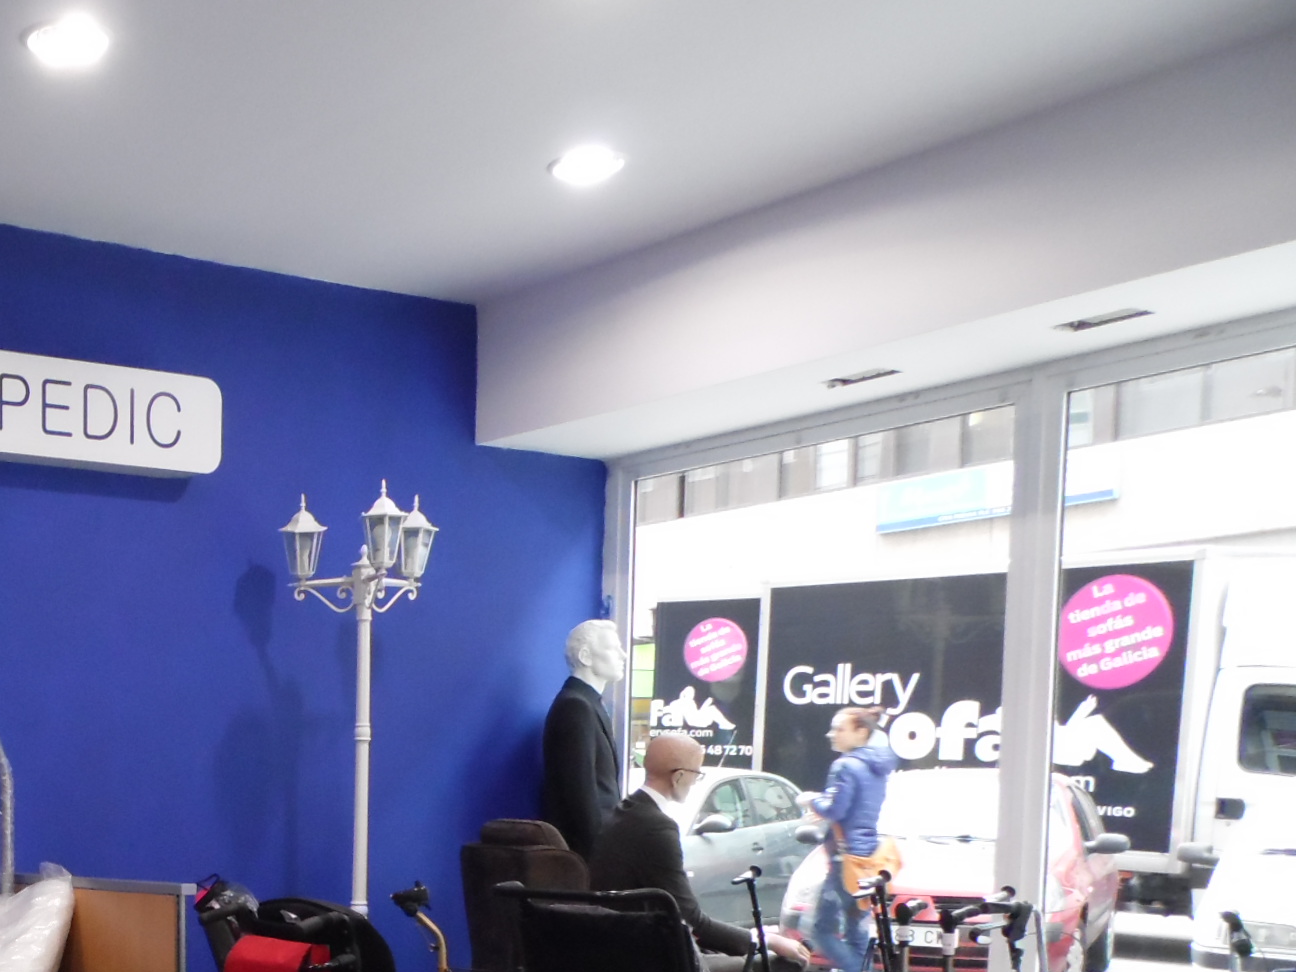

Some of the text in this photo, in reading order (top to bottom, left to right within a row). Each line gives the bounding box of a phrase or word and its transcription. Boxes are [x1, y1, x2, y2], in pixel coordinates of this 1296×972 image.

[1092, 583, 1115, 599] La
[1067, 592, 1147, 624] tienda de
[1086, 614, 1135, 637] sofás
[1066, 625, 1165, 662] más grande
[1076, 646, 1160, 678] de Galicia
[783, 662, 920, 715] Gallery
[879, 699, 1002, 763] ofa
[707, 745, 722, 756] 48
[738, 745, 753, 756] 70
[1097, 805, 1135, 818] VIGO
